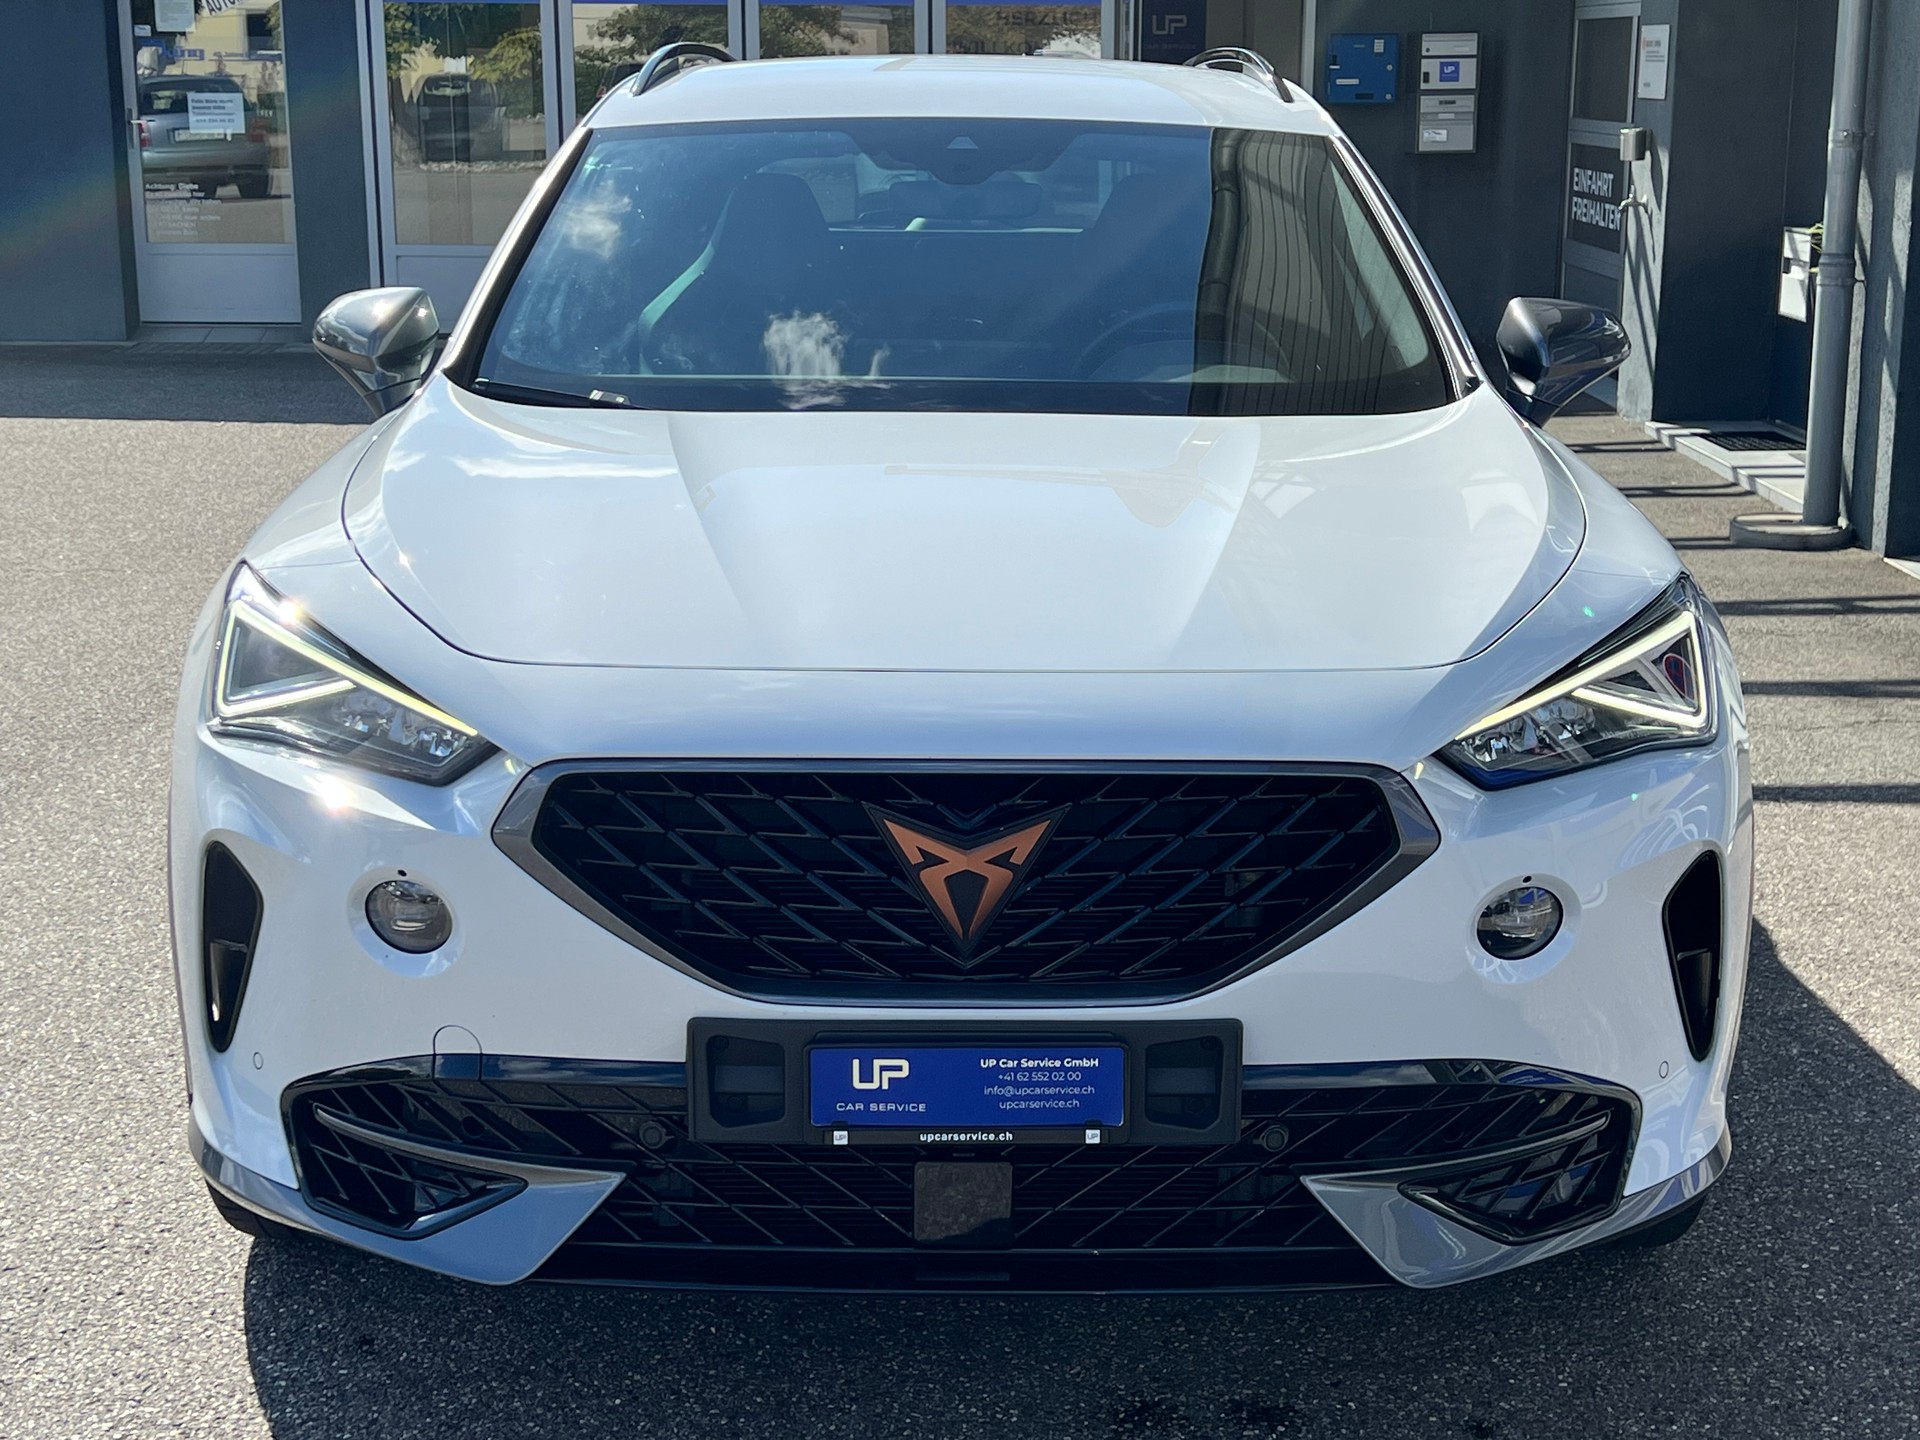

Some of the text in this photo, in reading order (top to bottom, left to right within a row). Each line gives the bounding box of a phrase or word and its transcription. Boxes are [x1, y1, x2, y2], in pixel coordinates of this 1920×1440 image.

[1152, 14, 1187, 35] UP
[1444, 65, 1456, 73] UP
[1573, 167, 1614, 198] EINFAHRT
[1572, 196, 1621, 231] FREIHALTEN
[980, 1057, 1099, 1068] UP Car Service GmbH
[852, 1058, 910, 1090] UP
[998, 1071, 1082, 1081] +41 62 552 02 00
[984, 1085, 1095, 1097] info@upcarservice.ch
[836, 1102, 926, 1112] CAR SERVICE
[999, 1098, 1080, 1110] upcarservice.ch
[919, 1132, 1013, 1143] upcarservice.ch
